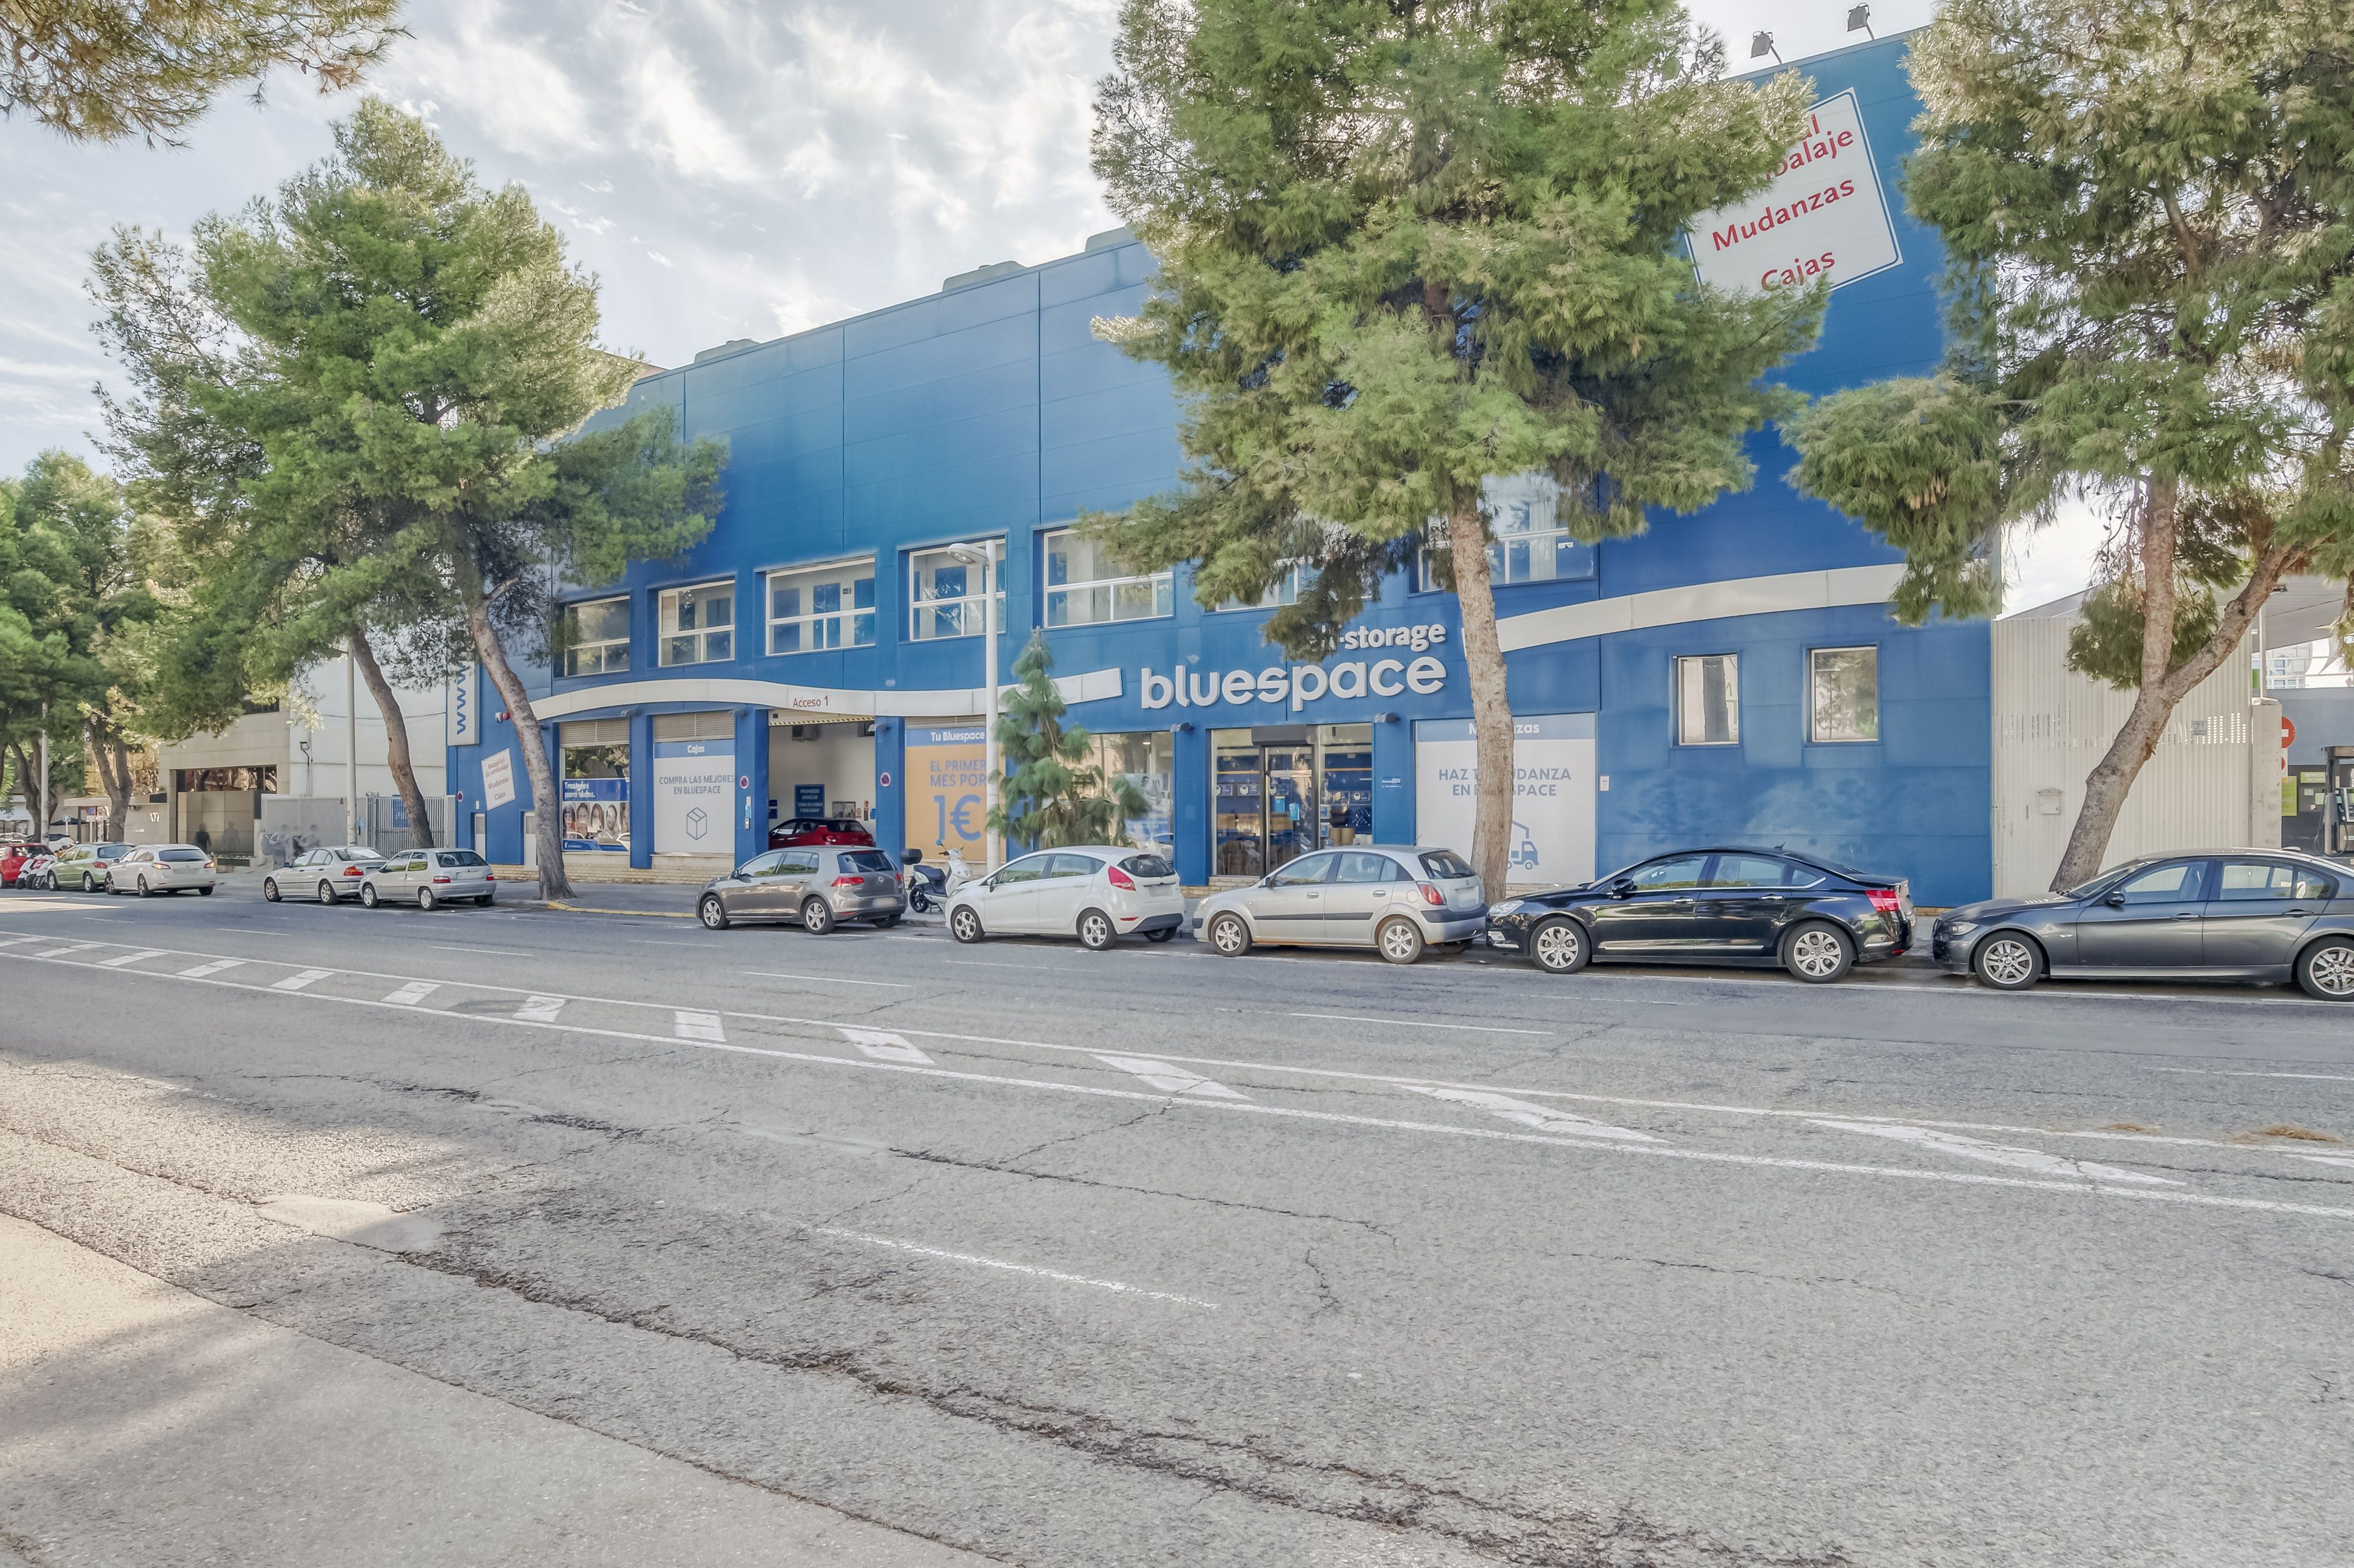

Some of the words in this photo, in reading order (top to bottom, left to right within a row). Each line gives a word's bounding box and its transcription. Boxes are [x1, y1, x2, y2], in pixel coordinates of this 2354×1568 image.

[1712, 179, 1855, 252] Mudanzas
[1141, 656, 1448, 712] bluespace
[793, 697, 821, 708] Acceso
[824, 694, 828, 706] 1
[931, 732, 941, 741] Tu
[943, 731, 985, 743] Bluespace
[687, 744, 705, 755] Cajas
[930, 760, 941, 772] EL
[945, 759, 987, 772] PRIMER
[659, 776, 688, 784] COMPRA
[703, 775, 735, 784] MEJORES
[930, 775, 956, 787] MES
[960, 773, 987, 787] POR
[1439, 769, 1468, 780] HAZ
[488, 776, 510, 789] Mudanzas
[495, 792, 506, 801] Cajas
[1453, 784, 1471, 796] EN
[934, 793, 982, 842] 1€
